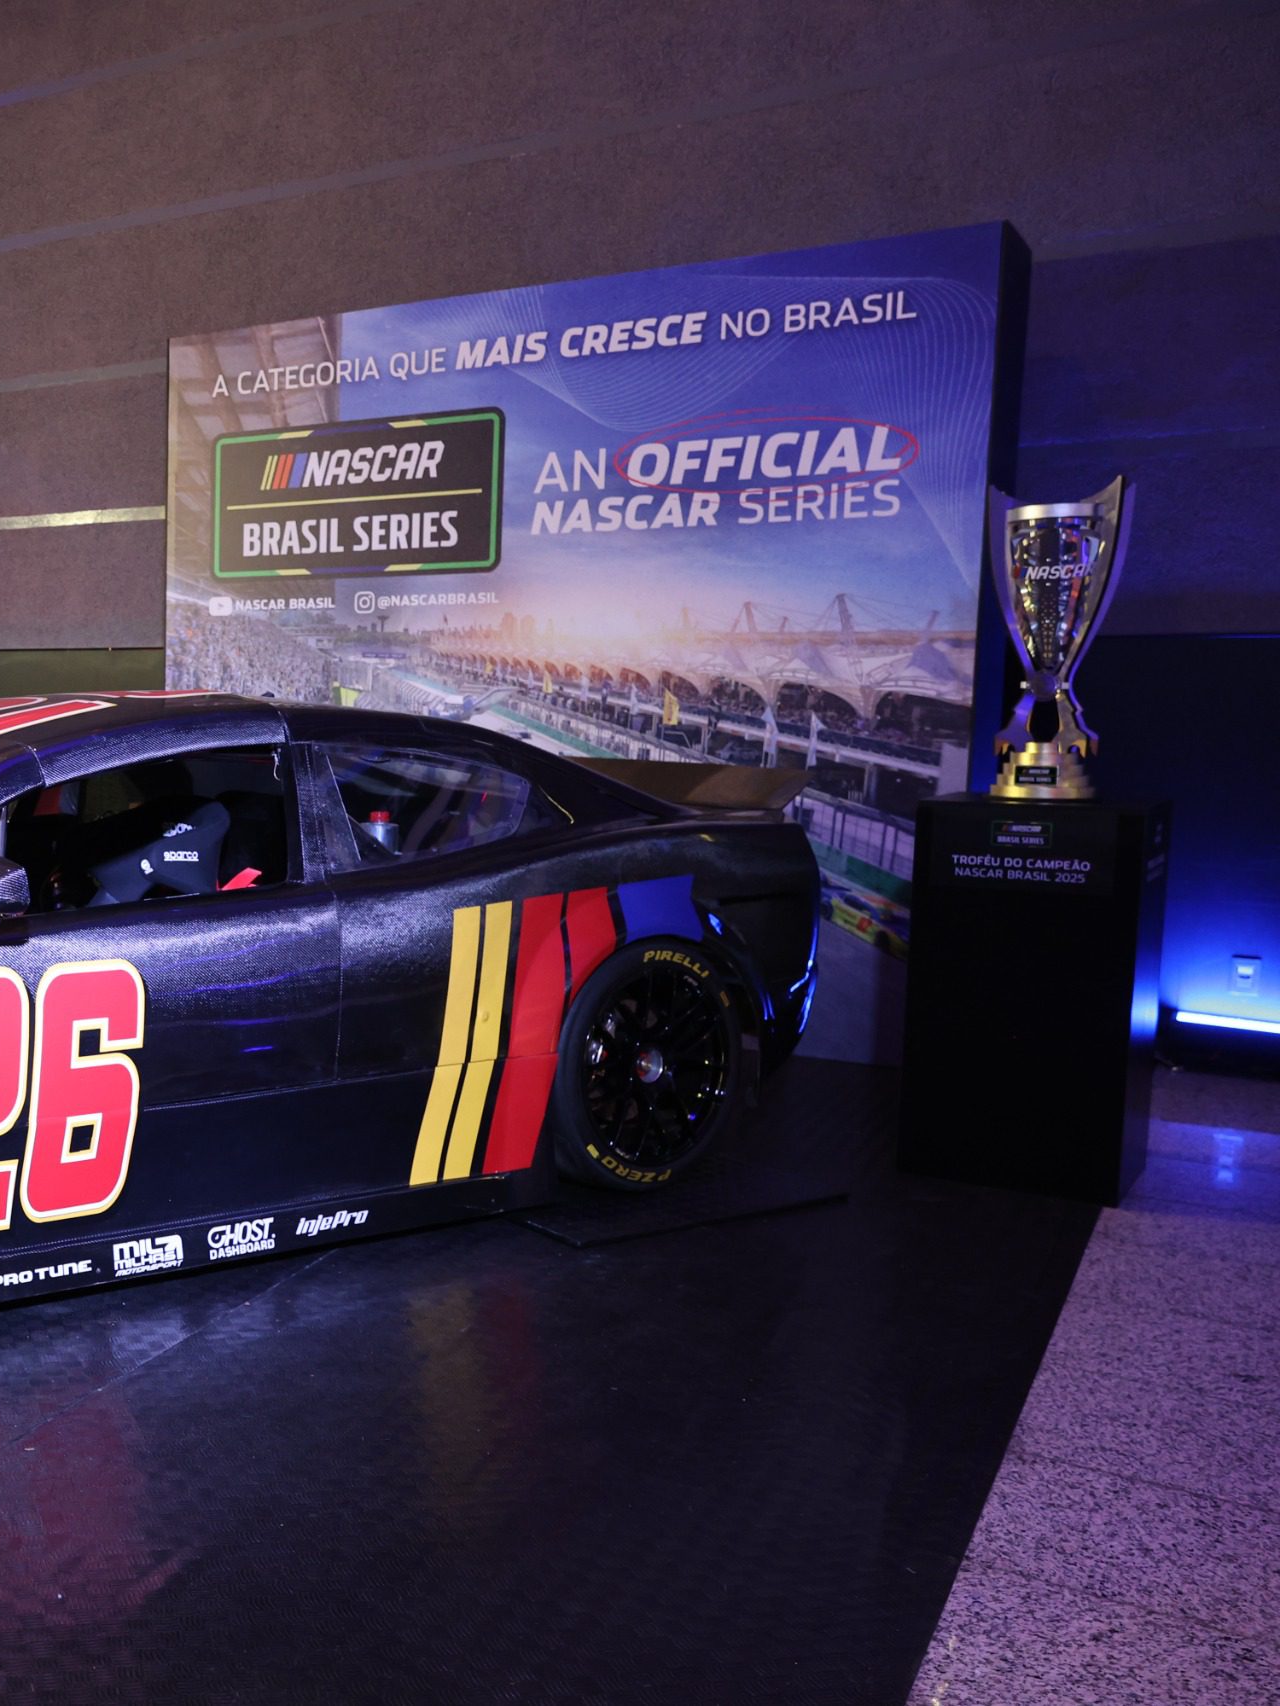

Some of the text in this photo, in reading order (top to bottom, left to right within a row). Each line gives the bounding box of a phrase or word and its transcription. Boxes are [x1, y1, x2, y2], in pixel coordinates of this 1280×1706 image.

[212, 291, 917, 398] A CATEGORIA QUE MAIS CRESCE NO BRASIL
[302, 440, 445, 488] NASCAR
[533, 424, 901, 494] AN OFFICIAL
[531, 479, 901, 535] NASCAR SERIES
[242, 510, 458, 557] BRASIL SERIES
[235, 597, 335, 612] NASCAR BRASIL
[377, 592, 499, 610] @NASCARBRASIL
[952, 854, 1091, 872] TROFÉU DO CAMPEÃO
[954, 867, 1085, 884] NASCAR BRASIL 2025
[643, 950, 709, 978] PIRELLI
[209, 1239, 275, 1260] DASHBOARD
[115, 1259, 184, 1277] MOTORSPORT
